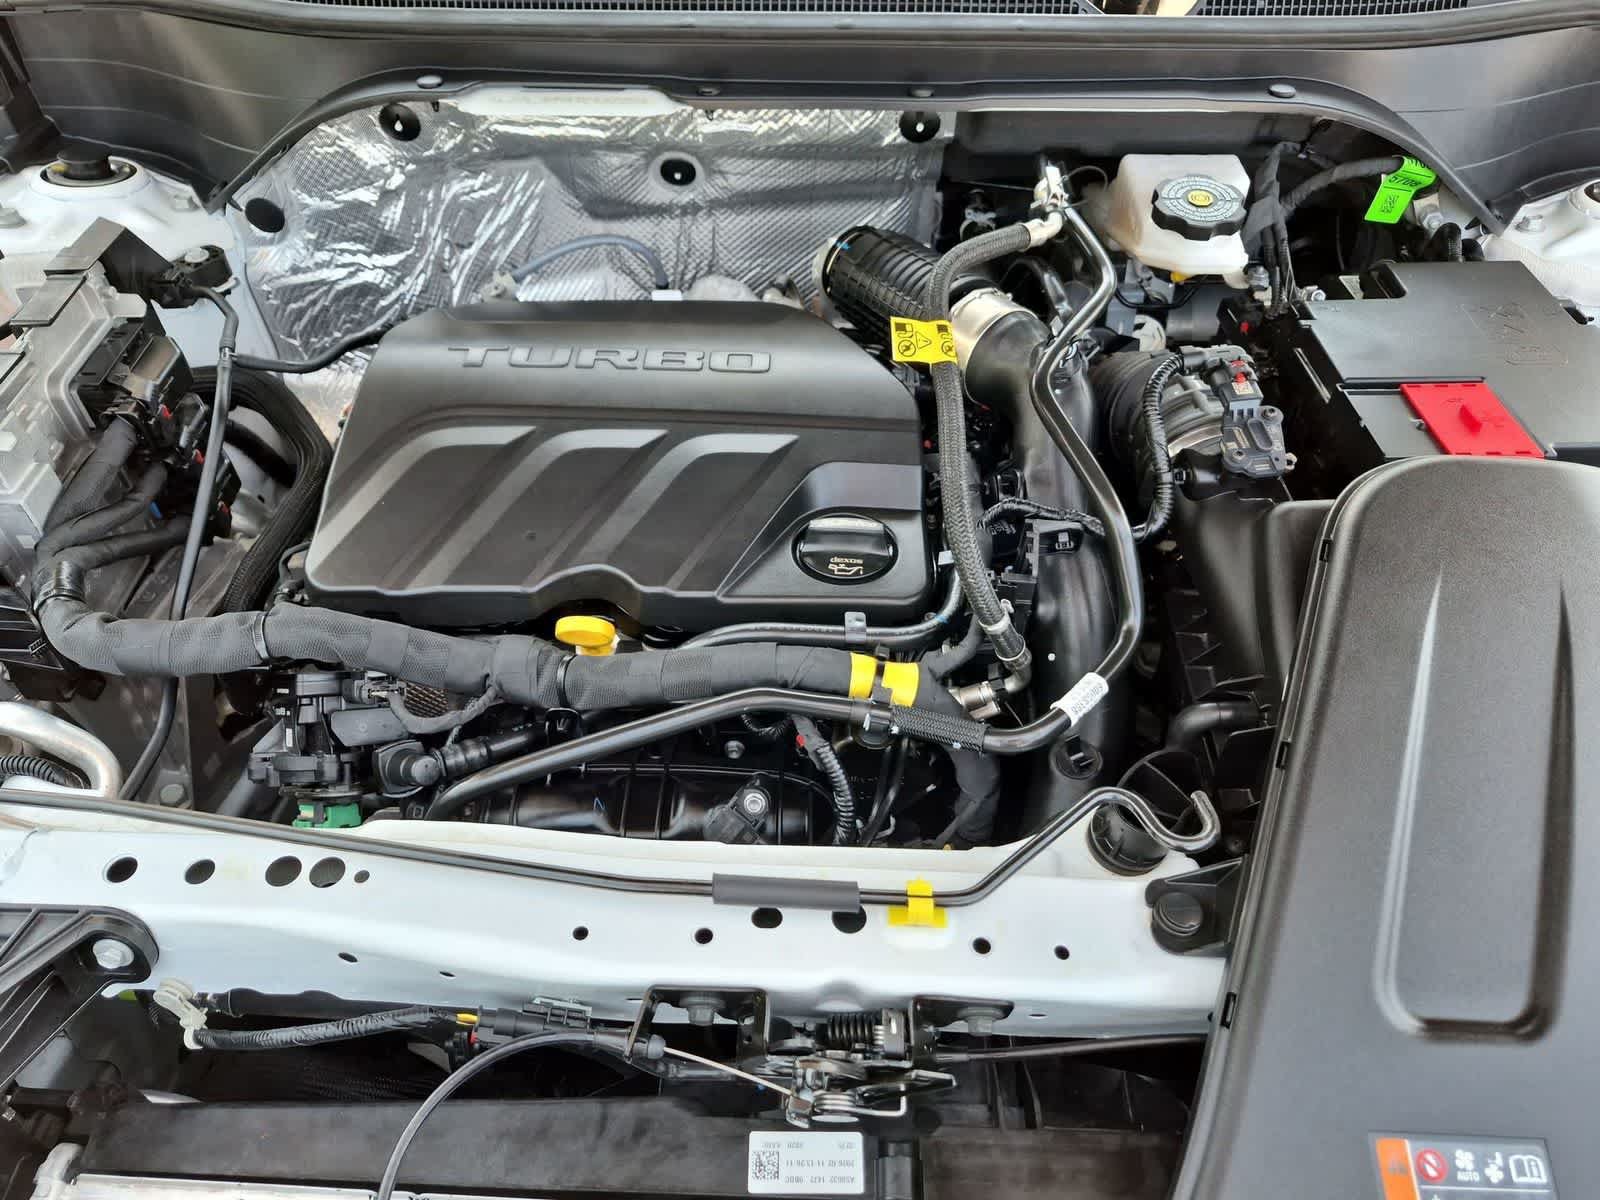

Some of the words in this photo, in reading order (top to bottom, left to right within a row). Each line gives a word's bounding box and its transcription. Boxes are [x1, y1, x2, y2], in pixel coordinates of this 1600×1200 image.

[447, 346, 771, 373] TURBO
[830, 556, 864, 564] dexos
[1456, 1170, 1480, 1182] AUTO
